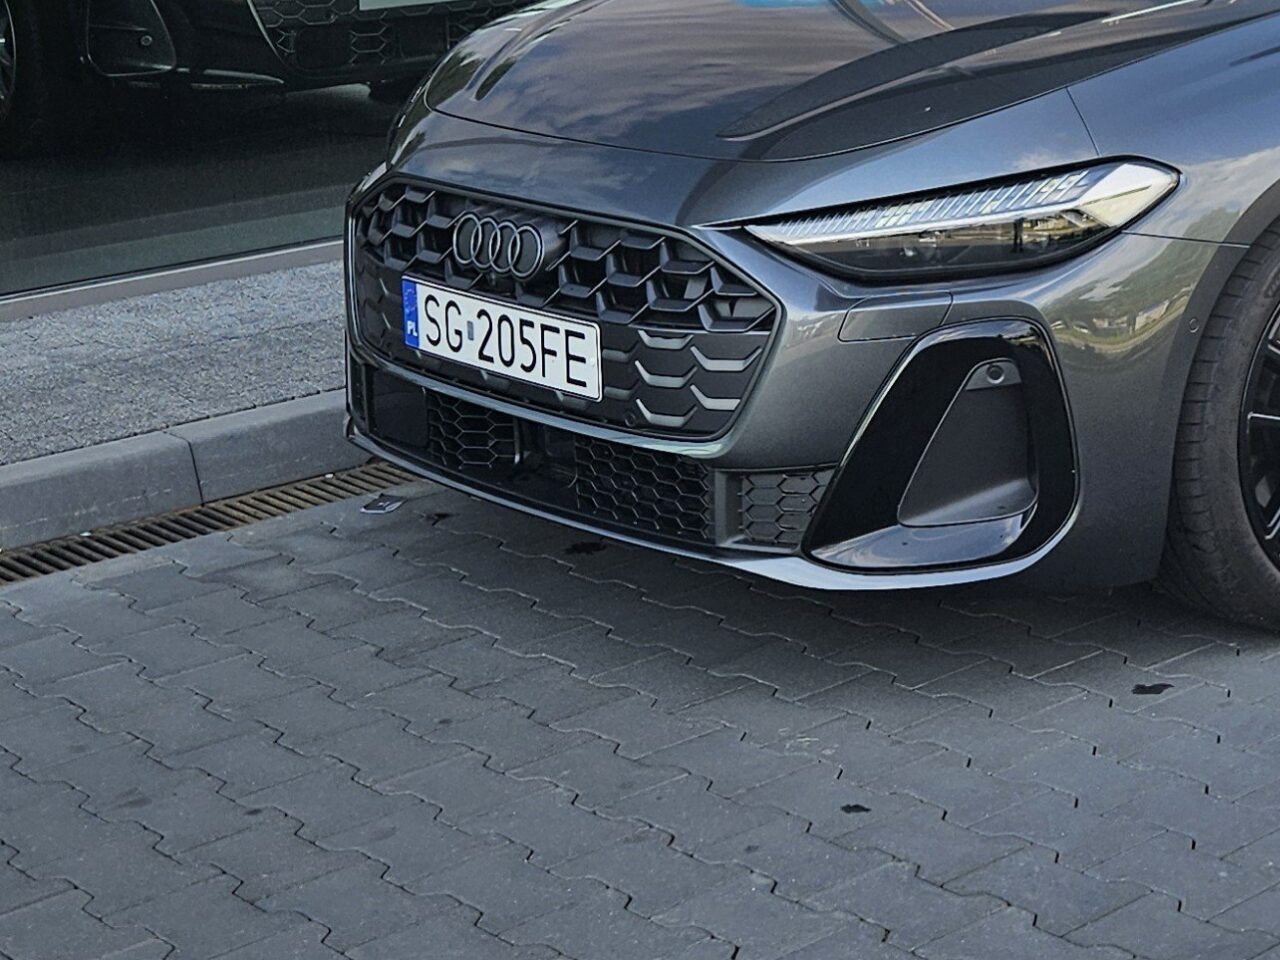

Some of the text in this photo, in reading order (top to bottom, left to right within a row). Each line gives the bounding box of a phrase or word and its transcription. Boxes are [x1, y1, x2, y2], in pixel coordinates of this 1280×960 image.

[406, 320, 418, 337] PL
[424, 294, 588, 388] SG 205FE
